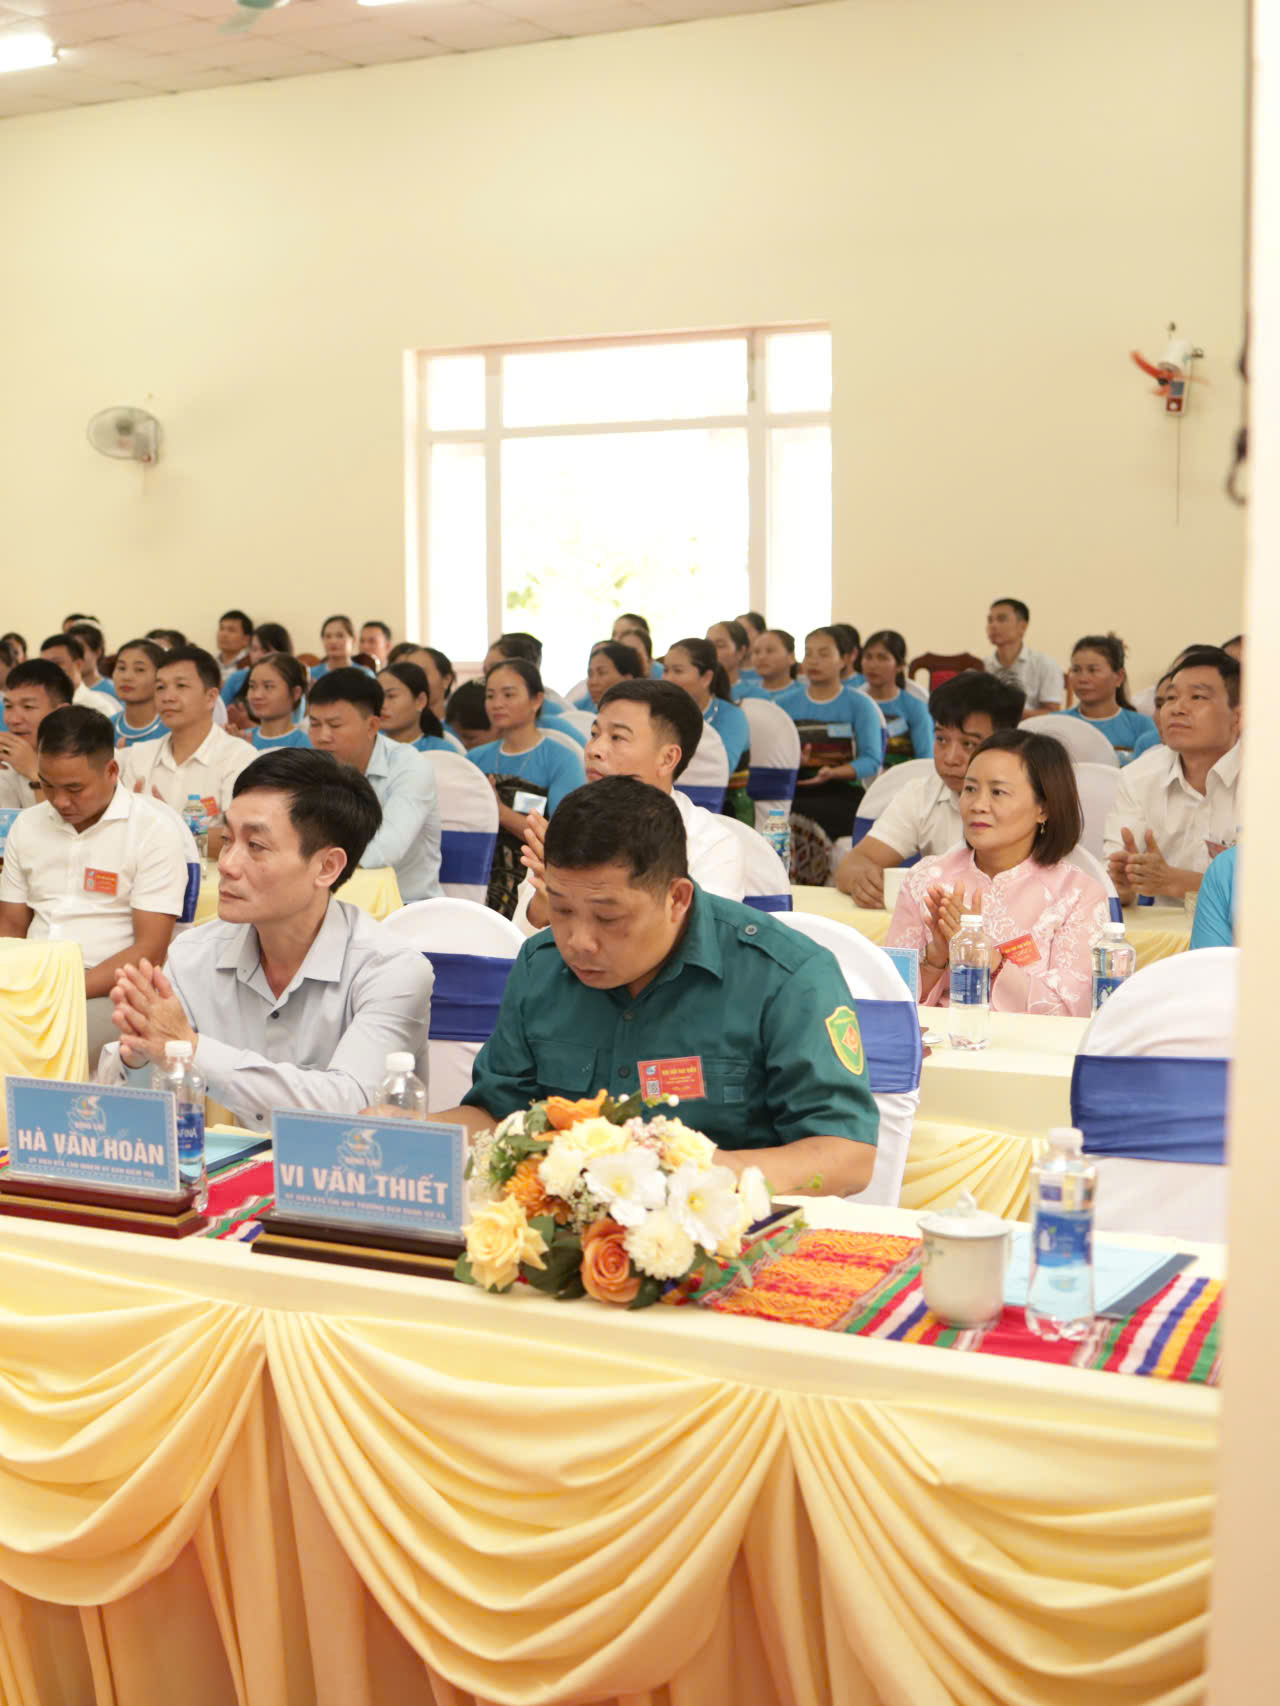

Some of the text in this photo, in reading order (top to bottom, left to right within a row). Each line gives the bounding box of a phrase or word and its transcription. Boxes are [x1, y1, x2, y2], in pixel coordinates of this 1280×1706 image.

[17, 1126, 48, 1153] HÀ
[52, 1130, 97, 1158] VĂN
[103, 1135, 165, 1167] HOÀN
[279, 1162, 449, 1206] VI VĂN THIẾT
